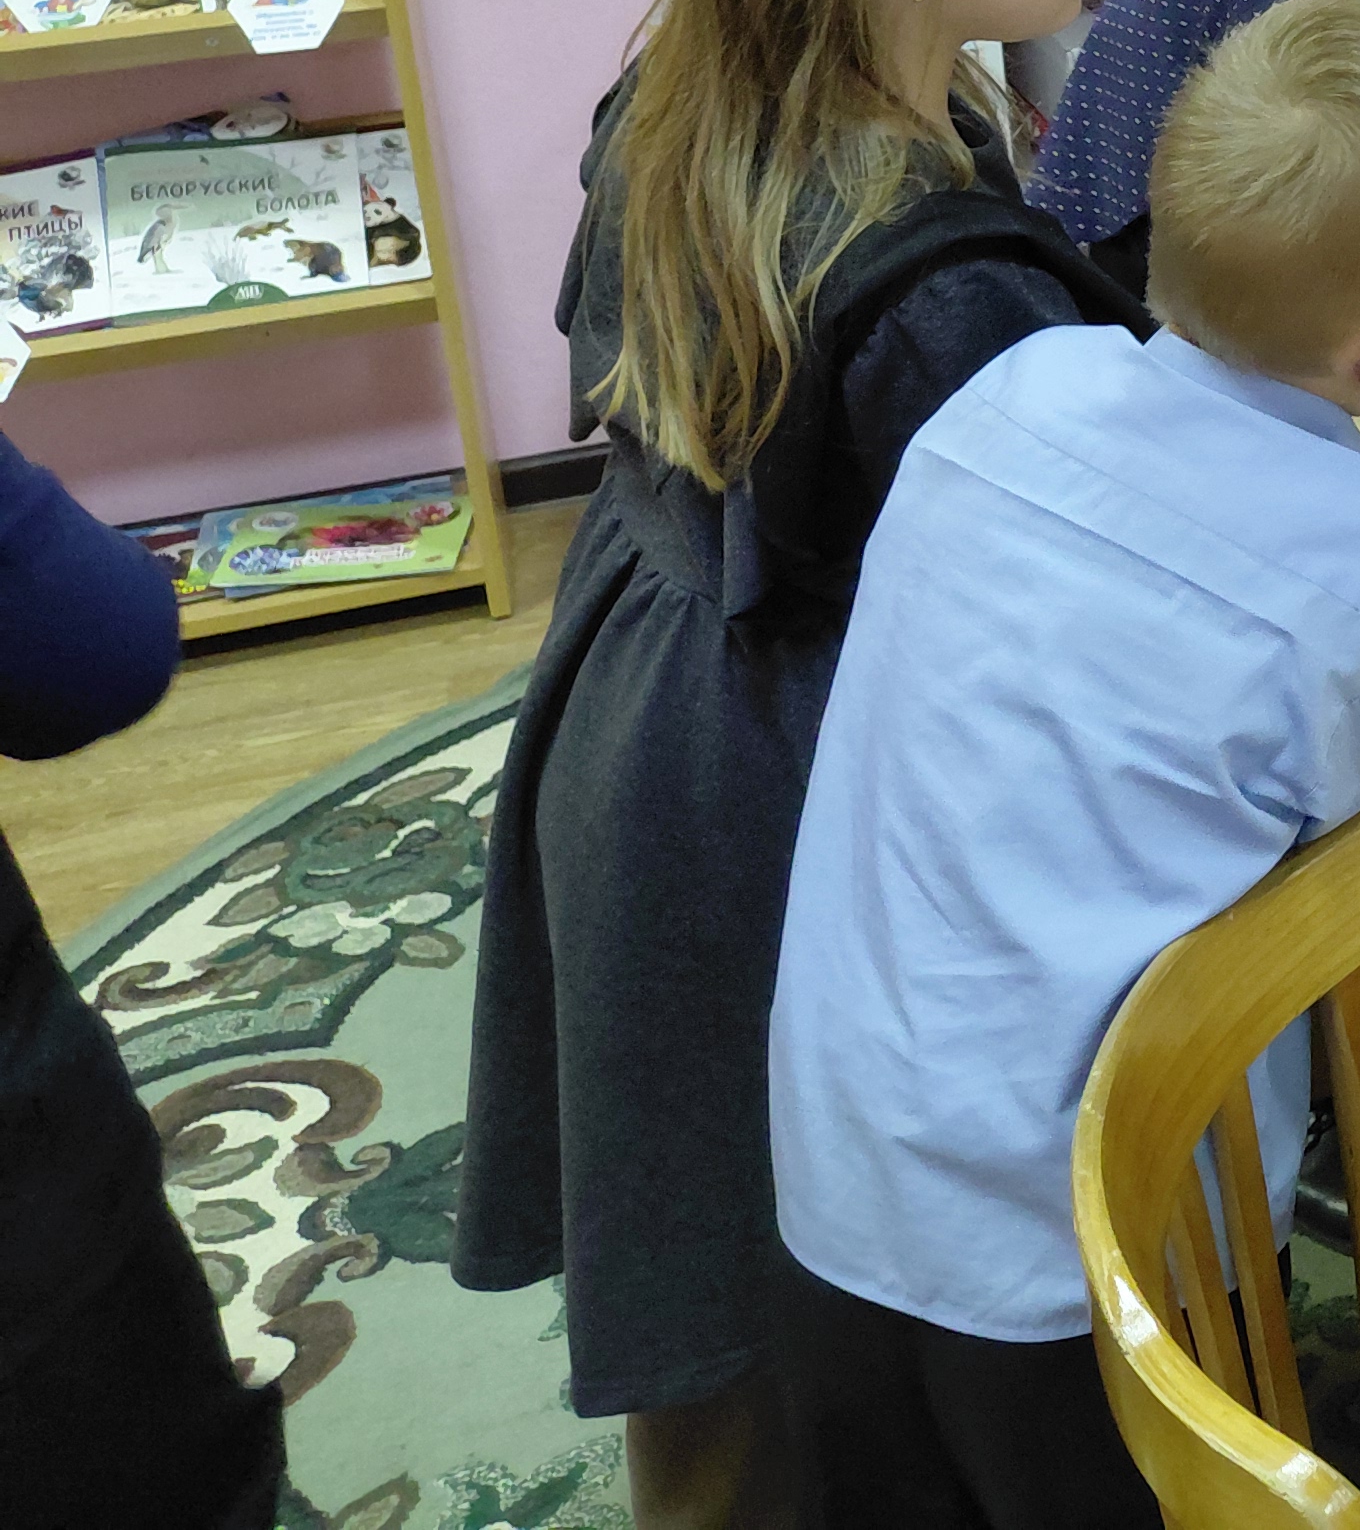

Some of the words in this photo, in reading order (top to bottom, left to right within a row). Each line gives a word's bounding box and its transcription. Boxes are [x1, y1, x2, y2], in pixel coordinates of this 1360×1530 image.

[130, 173, 280, 202] БЕЛОРУССКИЕ
[255, 191, 339, 214] БОЛОТА
[8, 216, 84, 243] ПТИЦЫ
